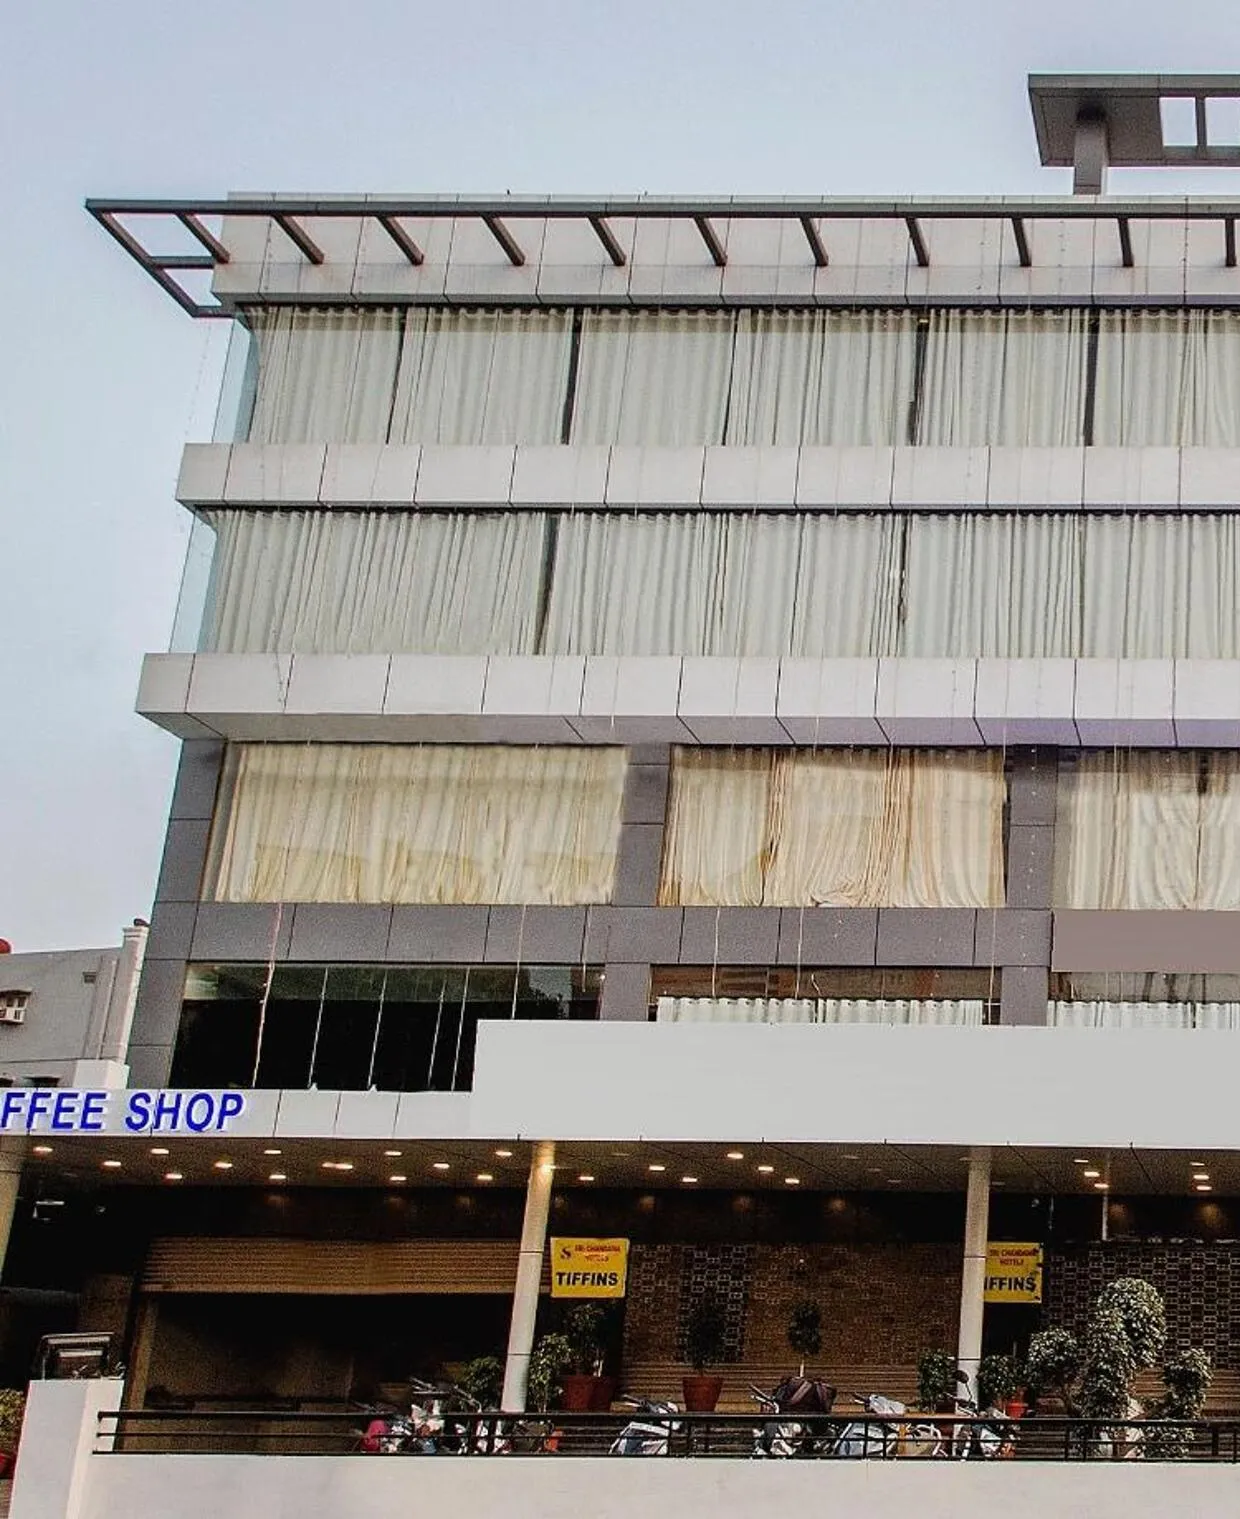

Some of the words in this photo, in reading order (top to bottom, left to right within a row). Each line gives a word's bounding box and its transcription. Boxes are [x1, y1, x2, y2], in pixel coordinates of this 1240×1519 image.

[125, 1092, 243, 1132] SHOP
[556, 1271, 619, 1287] TIFFINS
[984, 1276, 1036, 1292] IFFINS
